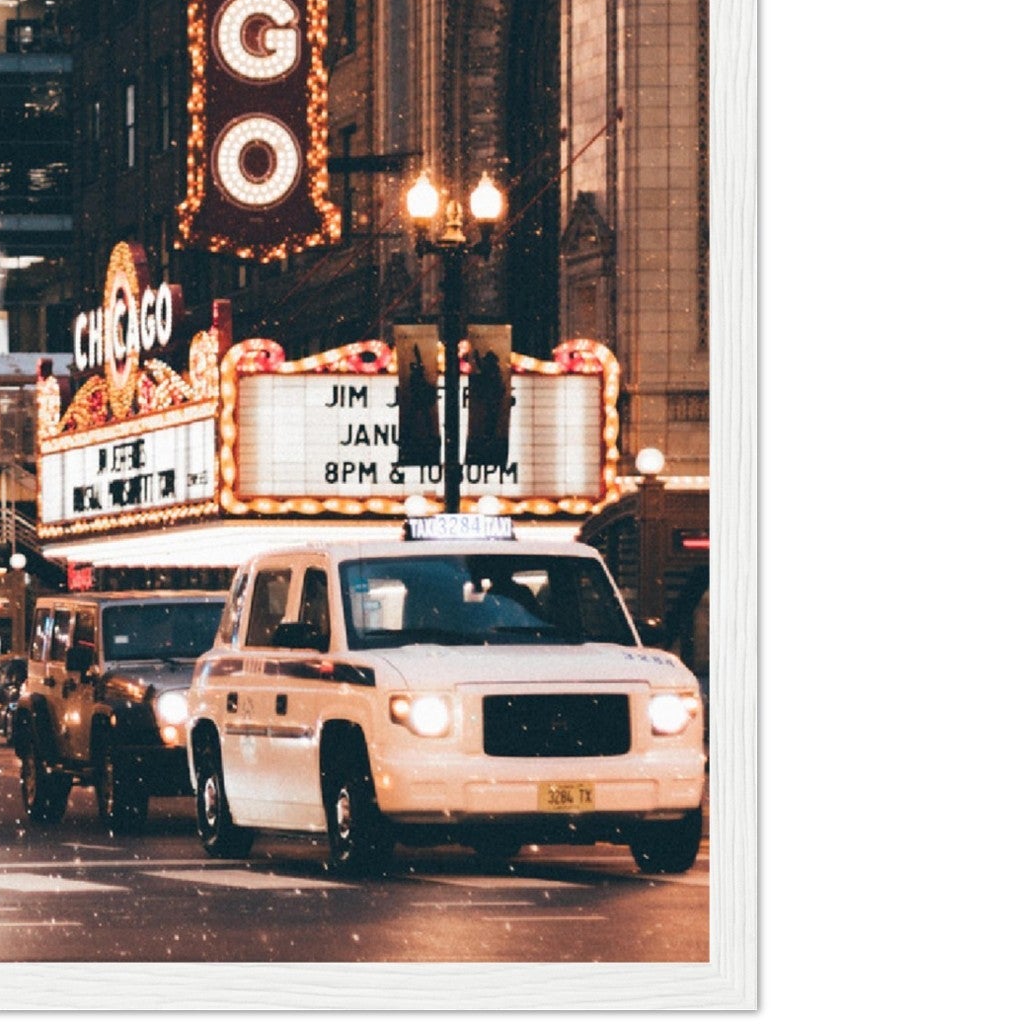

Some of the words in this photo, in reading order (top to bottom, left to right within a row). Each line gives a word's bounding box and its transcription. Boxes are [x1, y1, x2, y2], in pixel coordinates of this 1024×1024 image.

[74, 281, 172, 371] CHICAGO
[325, 385, 368, 408] JIM
[325, 461, 377, 484] 8PM
[420, 462, 518, 484] 100PM
[437, 516, 482, 535] 3284
